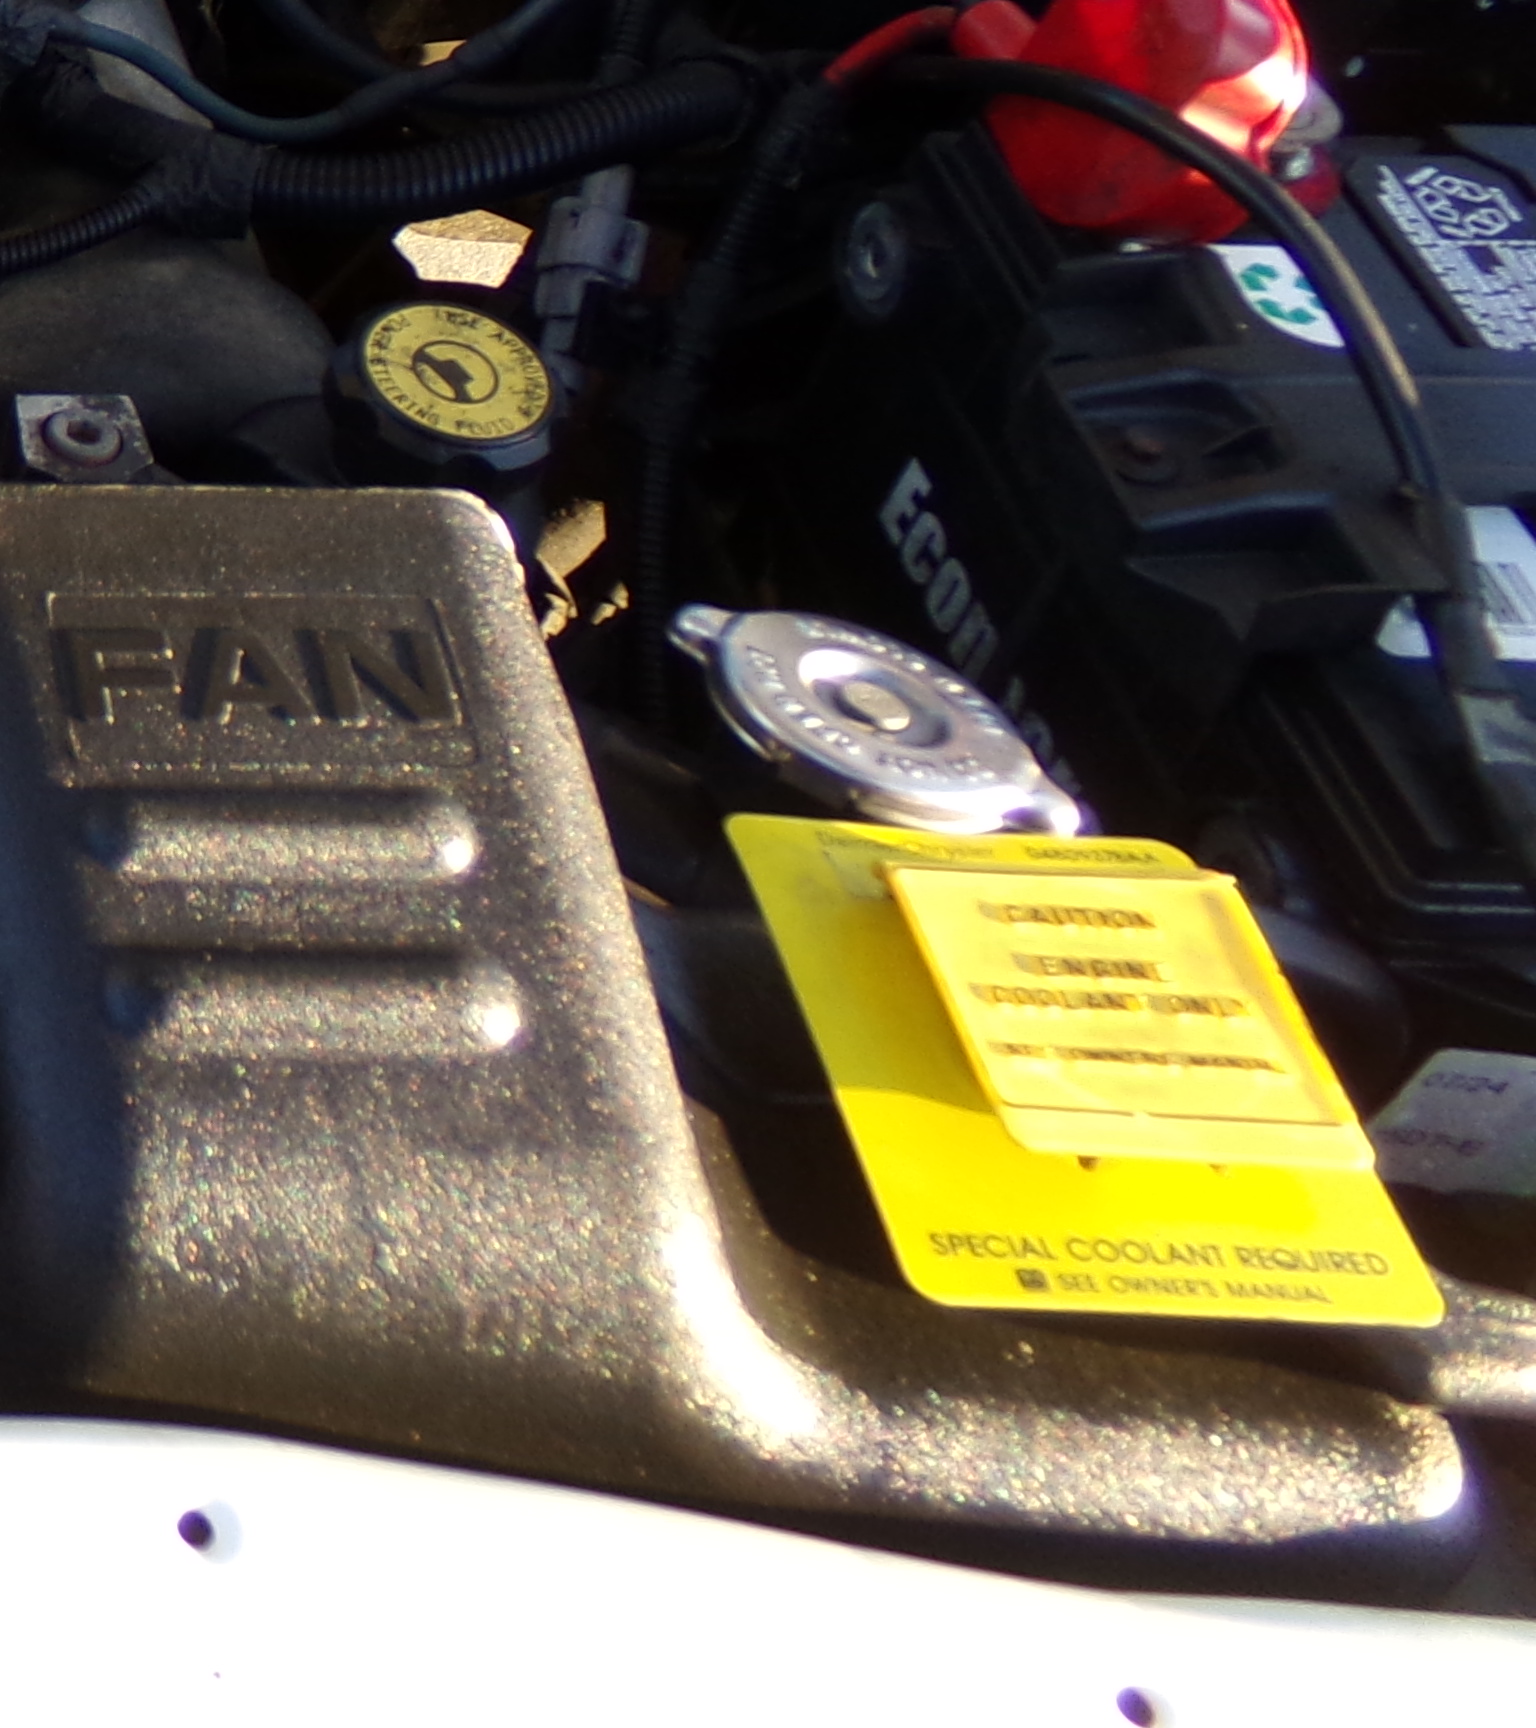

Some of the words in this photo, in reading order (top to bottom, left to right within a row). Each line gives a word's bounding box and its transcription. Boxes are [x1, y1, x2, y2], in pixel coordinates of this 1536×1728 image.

[48, 626, 463, 727] FAN
[929, 1231, 1057, 1262] SPECIAL
[1065, 1236, 1225, 1269] COOLANT
[1232, 1245, 1389, 1277] REQUIRED
[1056, 1271, 1101, 1294] SEE
[1226, 1279, 1334, 1304] MANUAL
